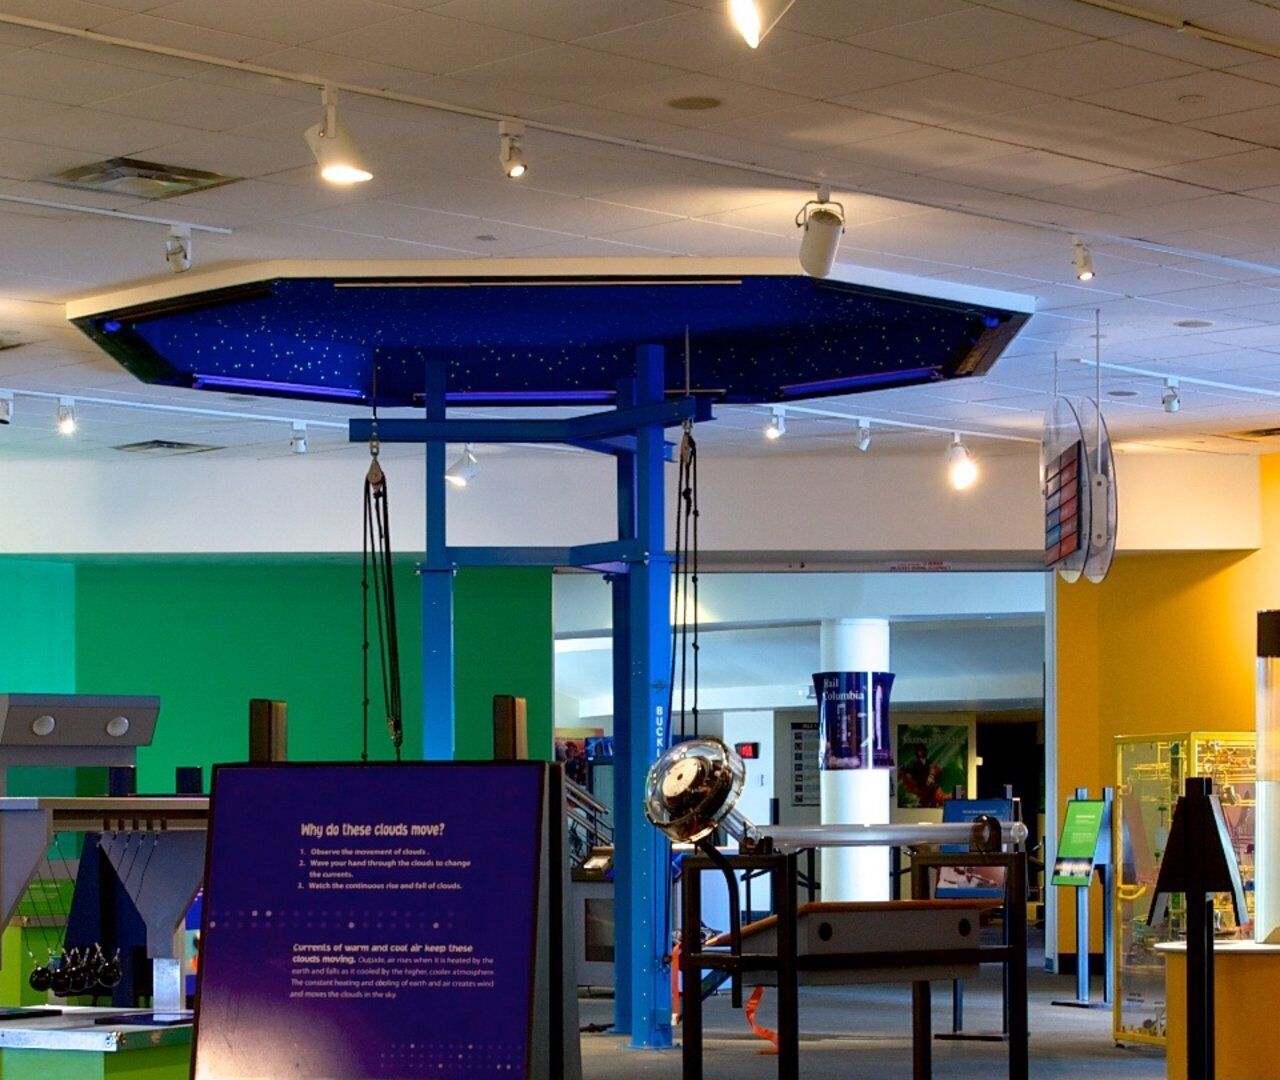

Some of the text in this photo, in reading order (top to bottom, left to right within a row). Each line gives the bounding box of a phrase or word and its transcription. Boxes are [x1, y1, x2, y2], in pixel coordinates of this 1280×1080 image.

[301, 823, 445, 838] Why do these clouds move?
[367, 860, 397, 868] through
[445, 860, 471, 868] change
[293, 943, 473, 953] Currents of warm and cool air keep these
[292, 955, 321, 963] clouds
[322, 955, 356, 965] moving.
